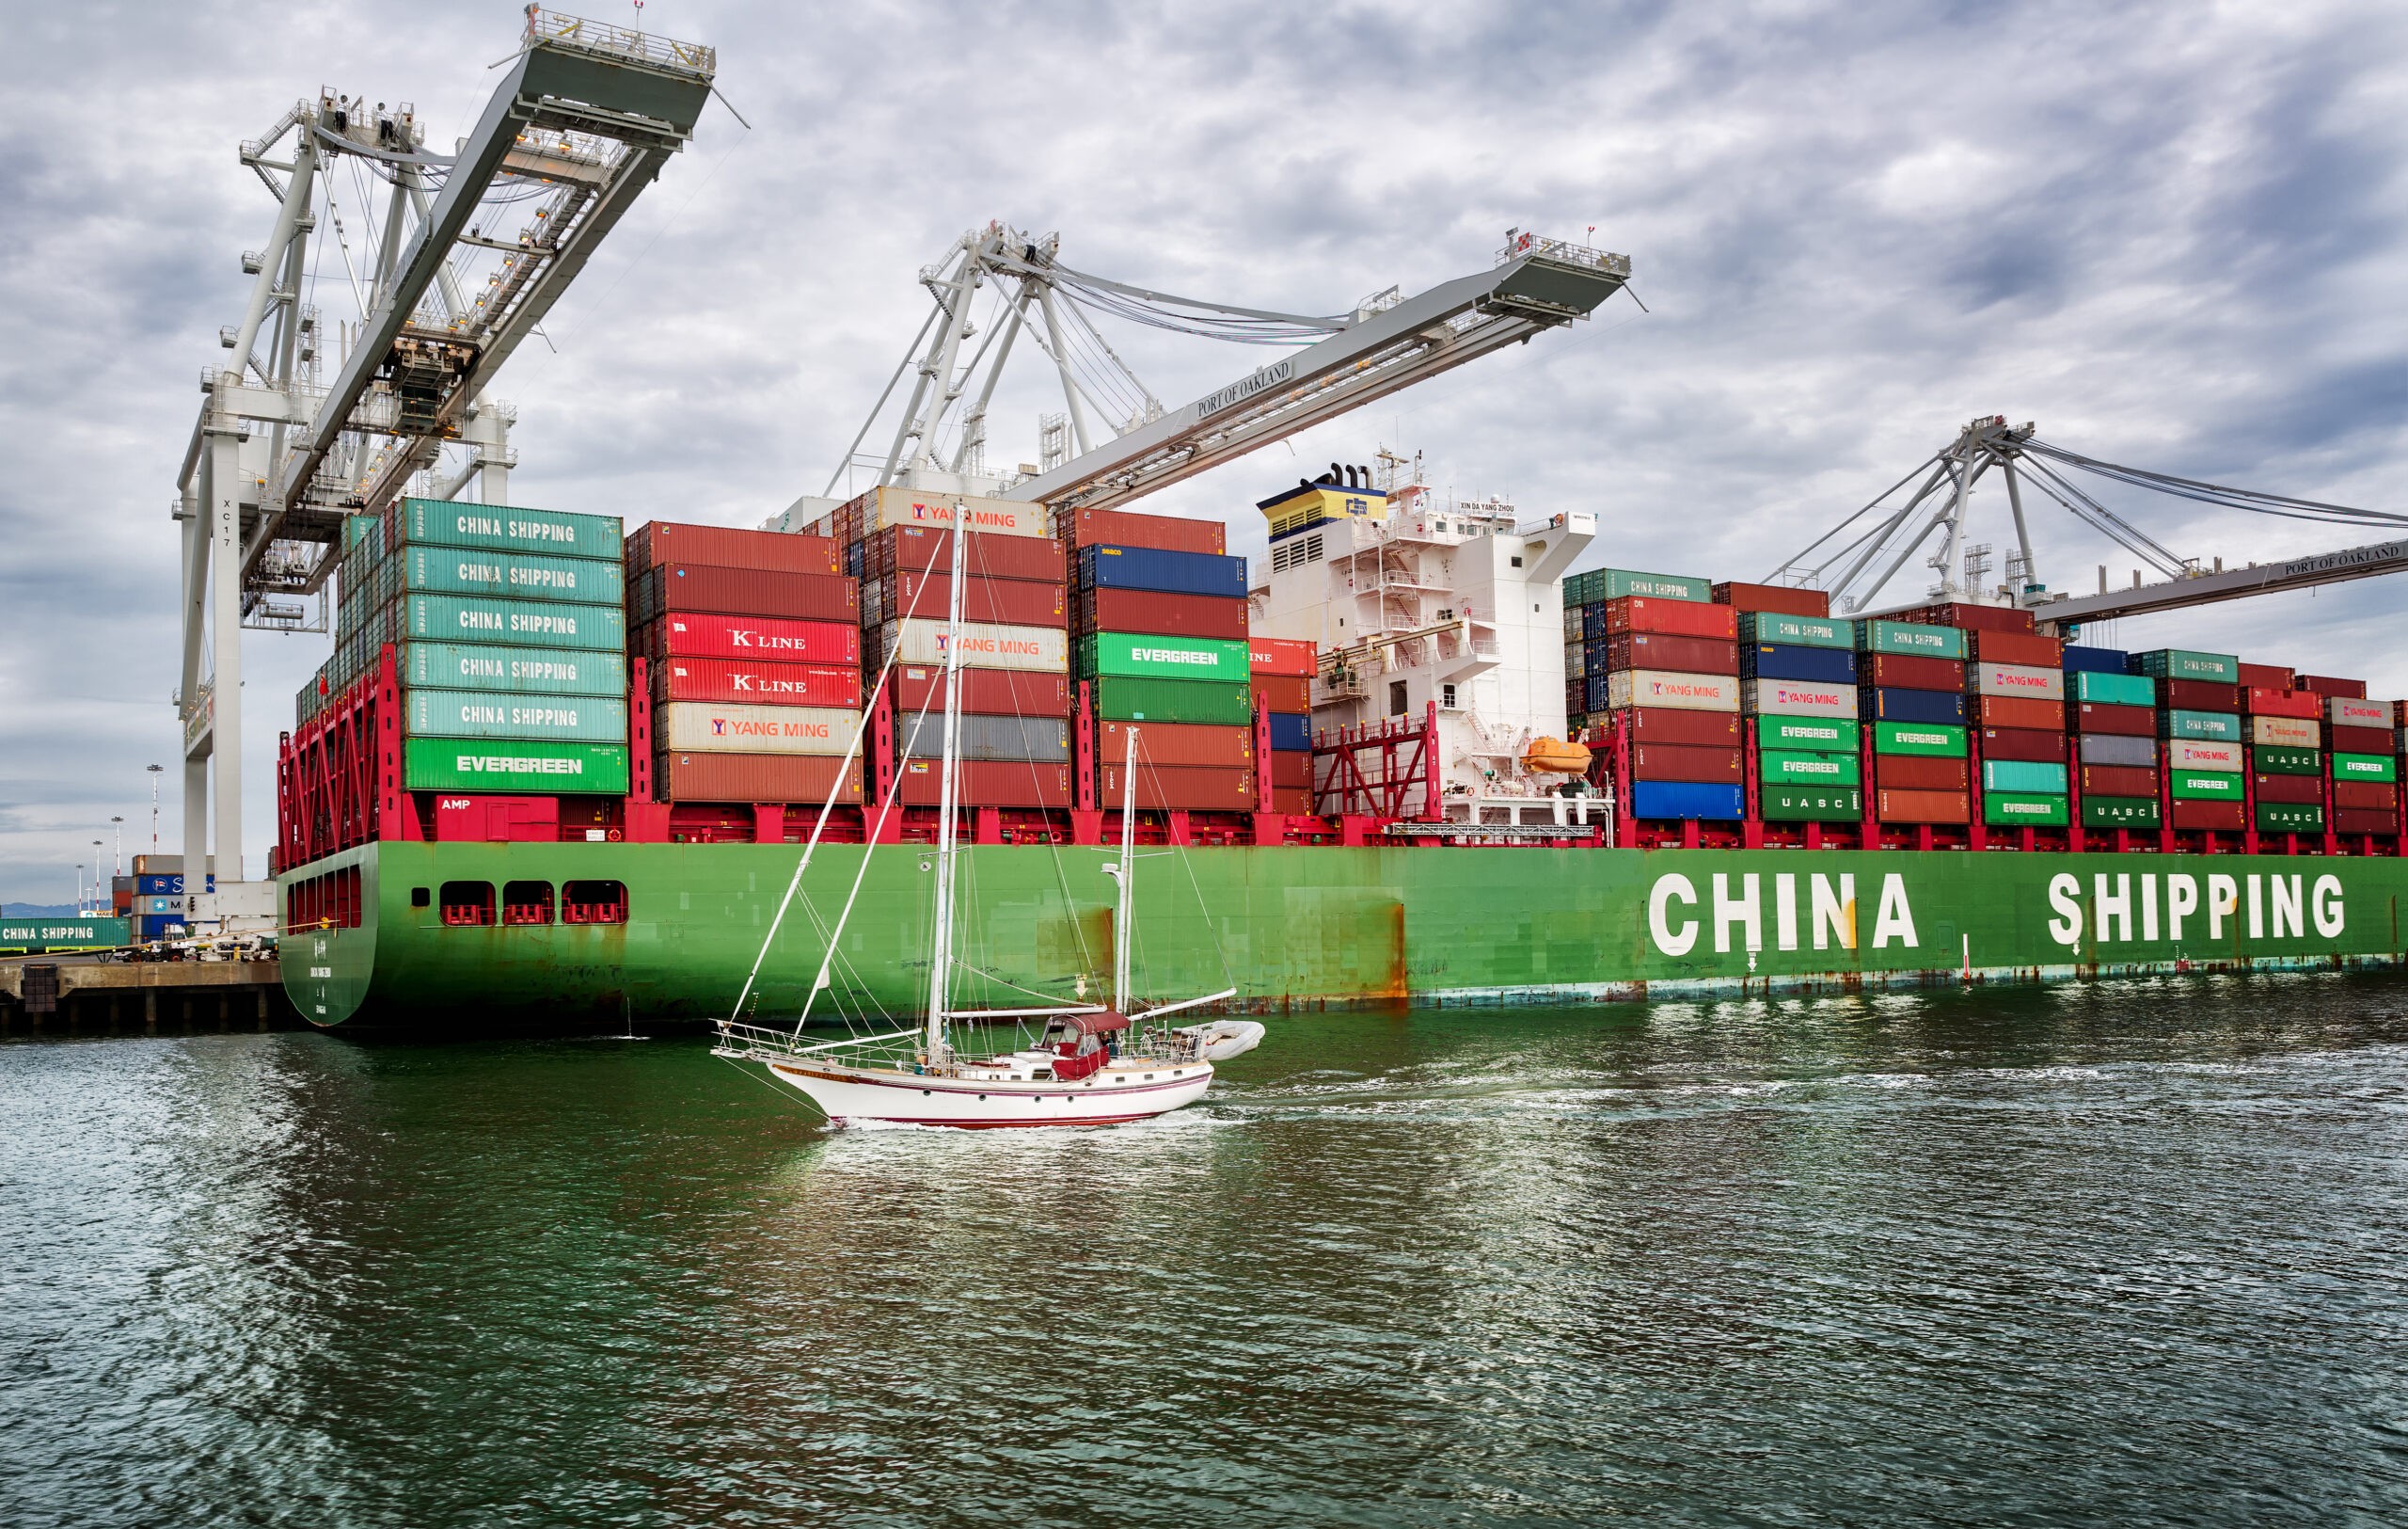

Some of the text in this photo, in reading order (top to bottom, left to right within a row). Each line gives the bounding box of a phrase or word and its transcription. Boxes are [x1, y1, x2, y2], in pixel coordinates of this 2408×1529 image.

[1197, 362, 1289, 417] PORT OF OAKLAND
[1460, 502, 1471, 510] XIN
[1481, 503, 1497, 512] YANG
[1497, 504, 1514, 513] ZHOU
[975, 511, 1015, 528] MING
[457, 516, 575, 543] CHINA SHIPPING
[2285, 546, 2399, 575] PORT OF OAKLAND
[458, 563, 576, 588] CHINA SHIPPING
[1630, 581, 1653, 594] CHINA
[1656, 583, 1687, 597] SHIPPING
[459, 611, 576, 634] CHINA SHIPPING
[1779, 623, 1799, 636] CHINA
[1802, 625, 1832, 638] SHIPPING
[758, 636, 805, 649] LINE
[1893, 632, 1912, 645] CHINA
[1915, 634, 1942, 646] SHIPPING
[957, 639, 994, 652] ANG
[999, 640, 1039, 655] MING
[1132, 647, 1218, 665] EVERGREEN
[1248, 652, 1273, 662] INE
[460, 658, 577, 680] CHINA SHIPPING
[759, 680, 806, 693] LINE
[2005, 676, 2048, 688] YANG MING
[1665, 683, 1691, 696] YANG
[1693, 686, 1719, 698] MING
[1788, 692, 1839, 706] YANG MING
[461, 705, 578, 726] CHINA SHIPPING
[731, 721, 779, 737] YANG
[784, 723, 829, 738] MING
[1781, 725, 1838, 740] EVERGREEN
[1895, 732, 1948, 745] EVERGREEN
[2192, 750, 2229, 761] YANG MING
[456, 756, 582, 774] EVERGREEN
[1782, 760, 1839, 773] EVERGREEN
[2187, 778, 2229, 790] EVERGREEN
[441, 800, 470, 810] AMP
[2003, 803, 2052, 814] EVERGREEN
[1648, 872, 2346, 957] CHINA SHIPPING
[3, 927, 93, 940] CHINA SHIPPING
